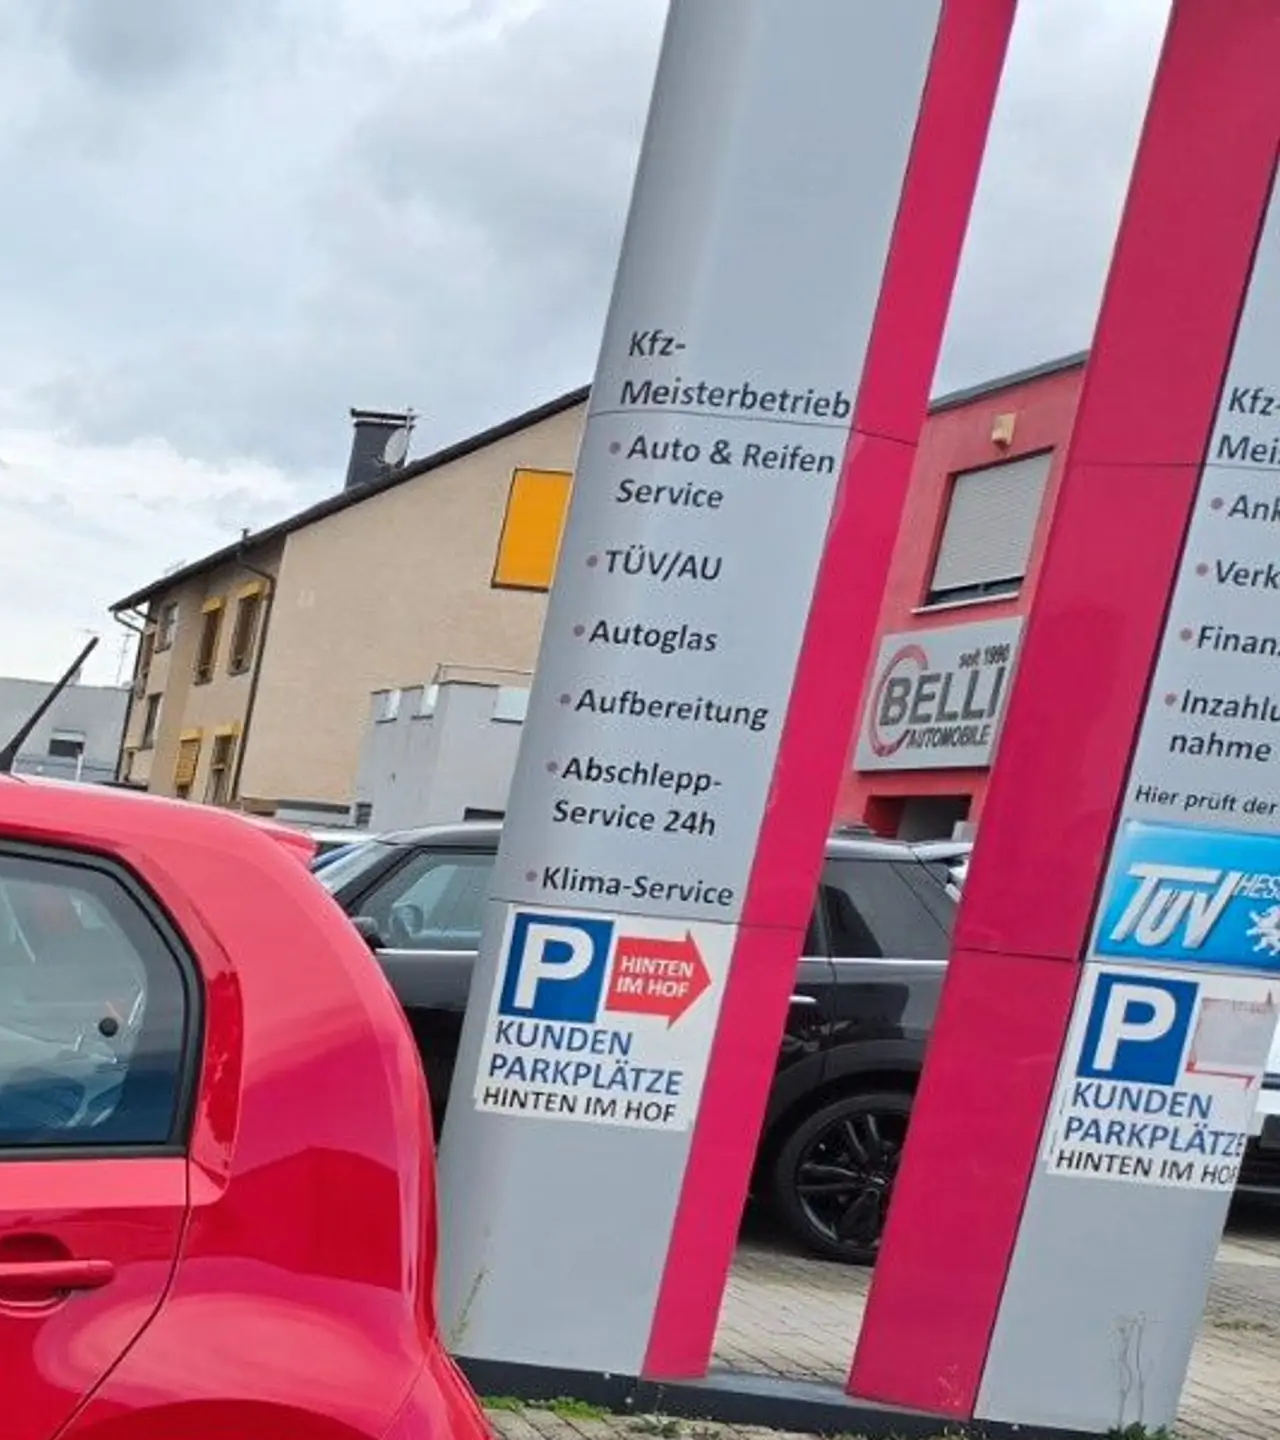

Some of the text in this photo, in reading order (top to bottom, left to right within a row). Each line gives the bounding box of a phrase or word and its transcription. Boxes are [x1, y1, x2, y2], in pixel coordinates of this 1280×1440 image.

[629, 329, 686, 357] Kfz-
[620, 376, 851, 419] Meisterbetrieb
[627, 434, 836, 474] Auto & Reifen
[1217, 433, 1280, 464] Mei
[616, 478, 723, 509] Service
[605, 544, 723, 582] TÜV/AU
[1215, 559, 1280, 590] Verk
[589, 619, 719, 654] Autoglas
[574, 688, 770, 732] Aufbereitung
[879, 665, 1006, 727] BELLI
[905, 724, 992, 750] AUTOMOBILE
[1169, 732, 1272, 762] nahme
[561, 756, 723, 796] Abschlepp-
[552, 799, 716, 837] Service 24h
[1135, 784, 1278, 816] Hier prüft der
[542, 866, 735, 907] Klima-Service
[1109, 862, 1245, 950] TÜV
[513, 922, 596, 1010] P
[621, 955, 694, 978] HINTEN
[616, 975, 691, 998] IM HOF
[495, 1019, 633, 1057] KUNDEN
[1093, 981, 1177, 1072] P
[488, 1053, 684, 1096] PARKPLÄTZE
[483, 1086, 677, 1123] HINTEN IM HOF
[1071, 1081, 1213, 1120] KUNDEN
[1056, 1149, 1154, 1177] HINTEN
[1160, 1159, 1196, 1181] IM
